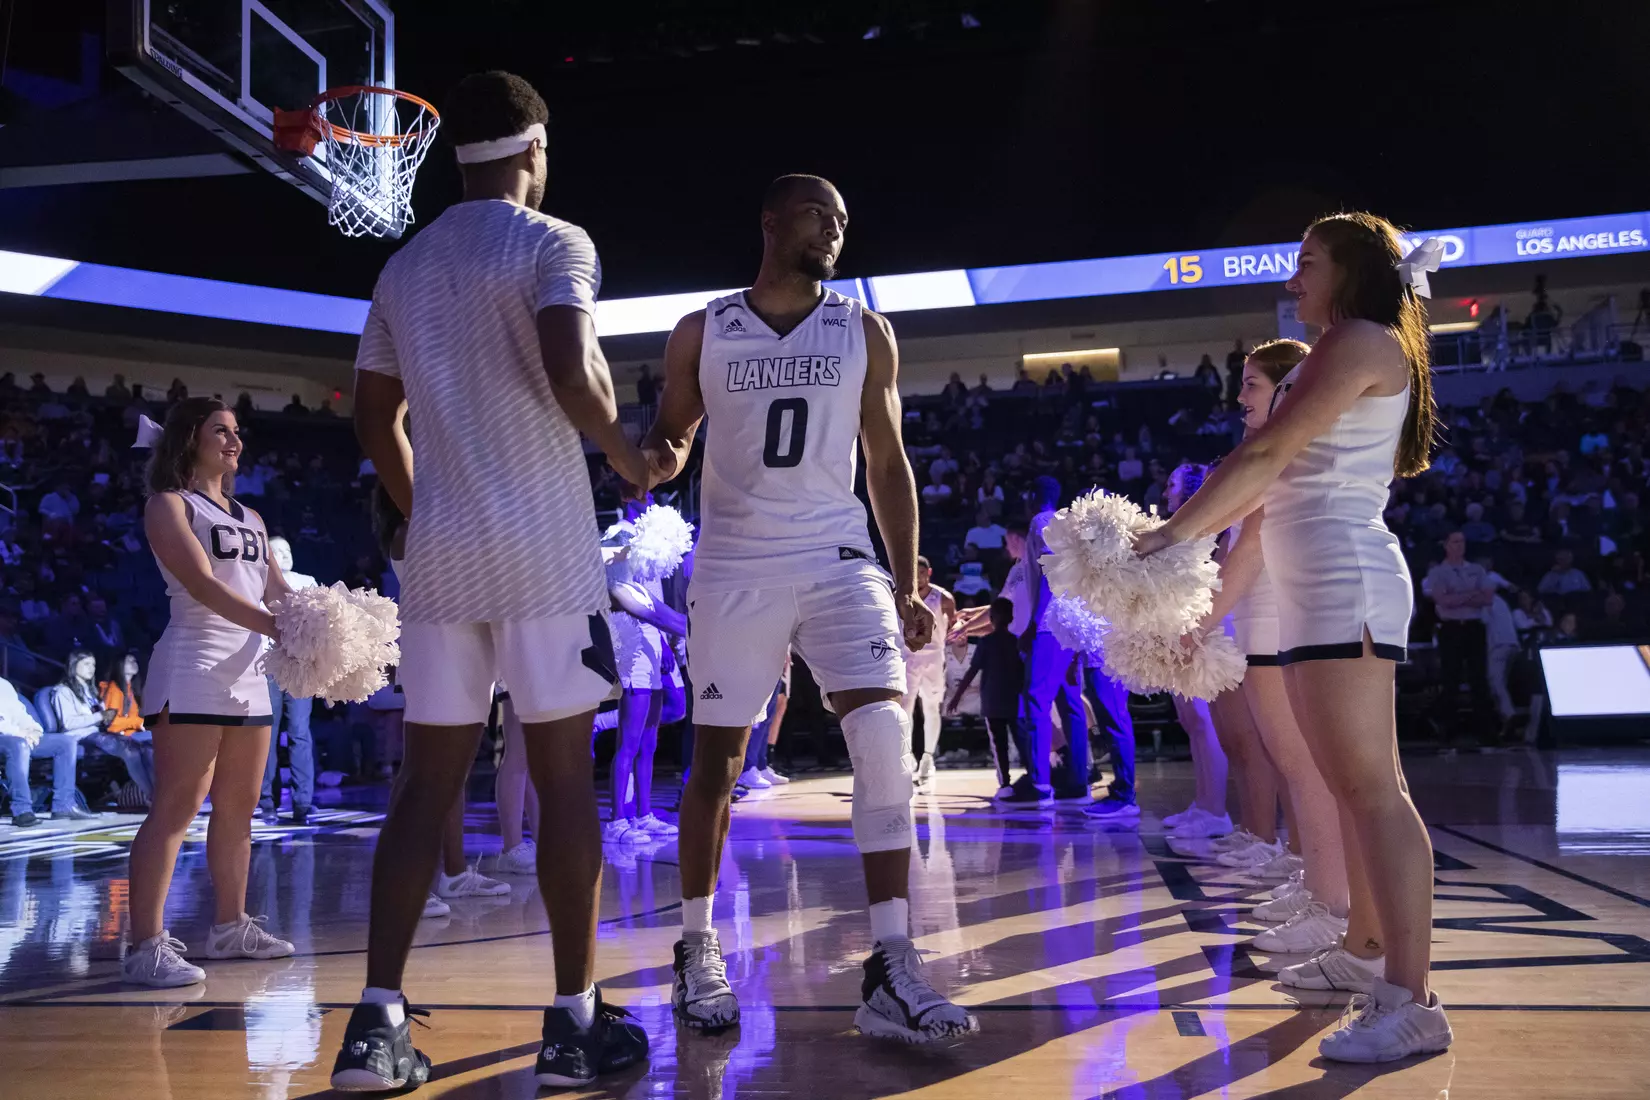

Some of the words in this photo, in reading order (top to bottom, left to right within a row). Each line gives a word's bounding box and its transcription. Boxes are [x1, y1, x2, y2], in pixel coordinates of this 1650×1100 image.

[1516, 237, 1554, 256] LOS
[1556, 229, 1648, 252] ANGELES,
[1163, 255, 1203, 284] 15
[822, 318, 847, 328] WAC
[727, 355, 841, 392] LANCERS
[763, 397, 809, 468] 0
[700, 692, 723, 700] adidas
